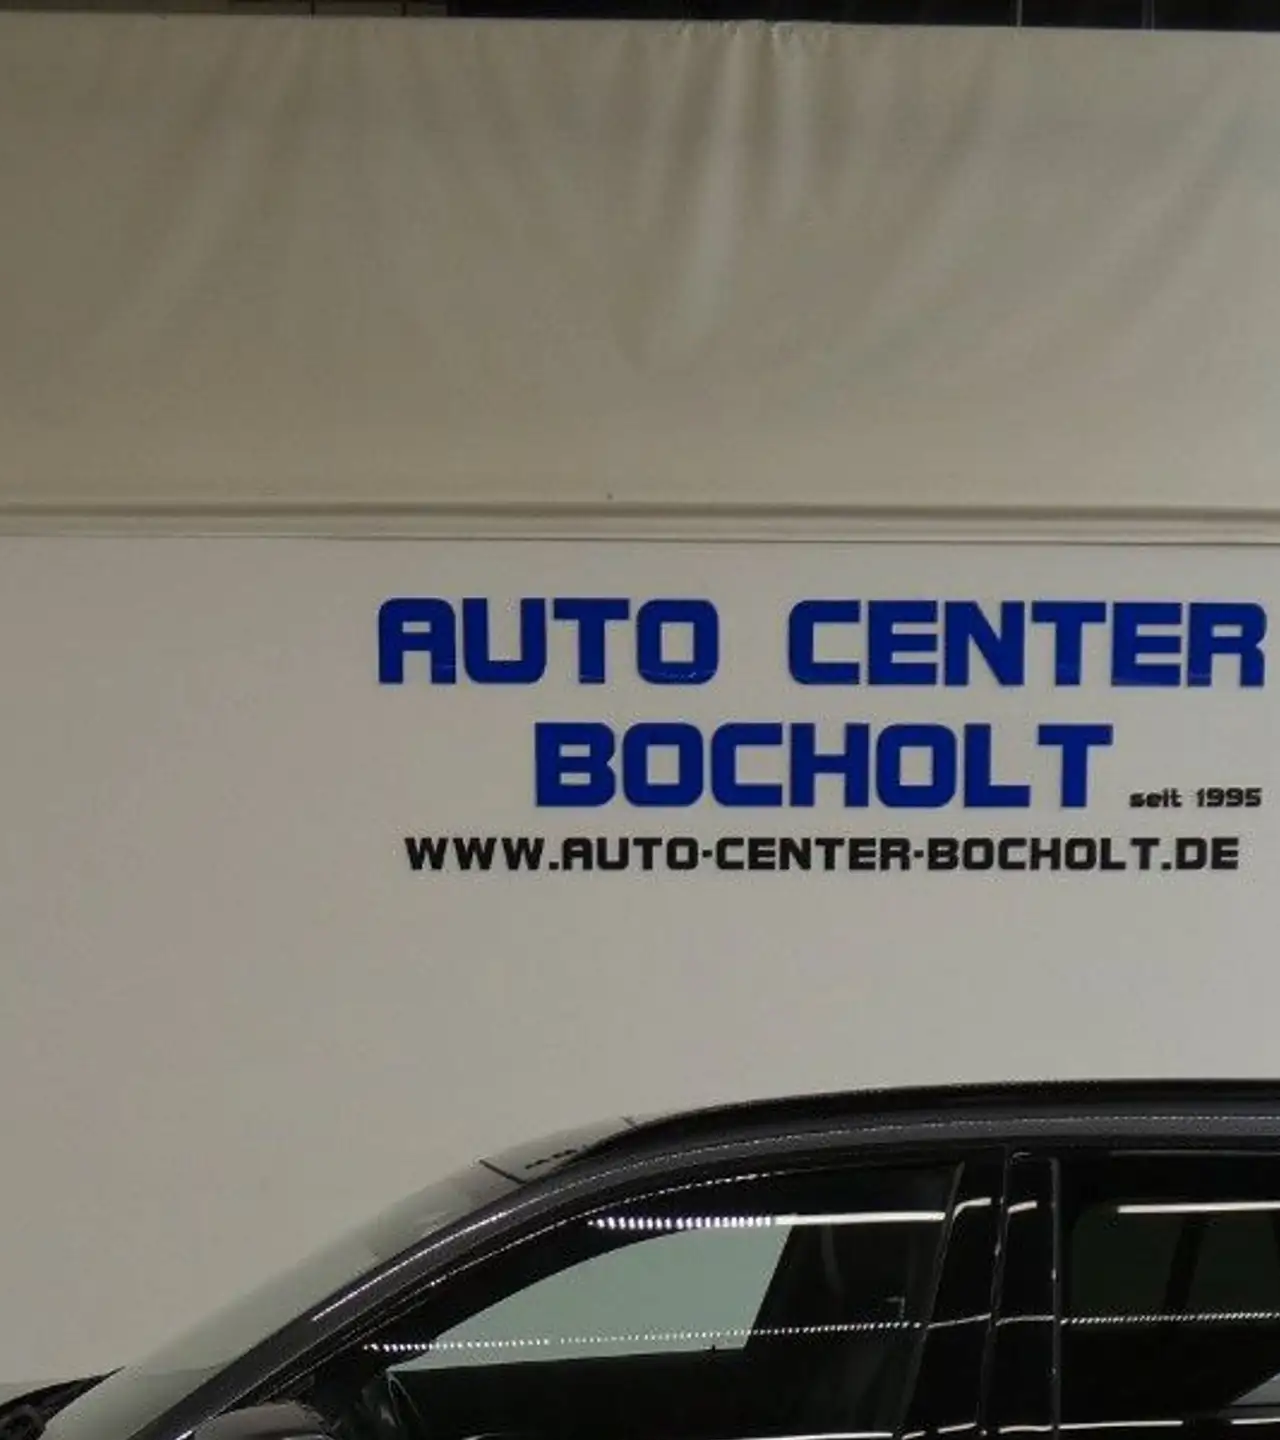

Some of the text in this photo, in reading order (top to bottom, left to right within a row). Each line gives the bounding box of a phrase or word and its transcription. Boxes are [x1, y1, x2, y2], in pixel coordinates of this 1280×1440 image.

[377, 597, 1268, 688] AUTO CENTER
[534, 721, 1114, 809] BOCHOLT
[1128, 786, 1263, 809] seit 1995
[404, 836, 1240, 872] WWW.AUTO-CENTER-BOCHOLT.DE
